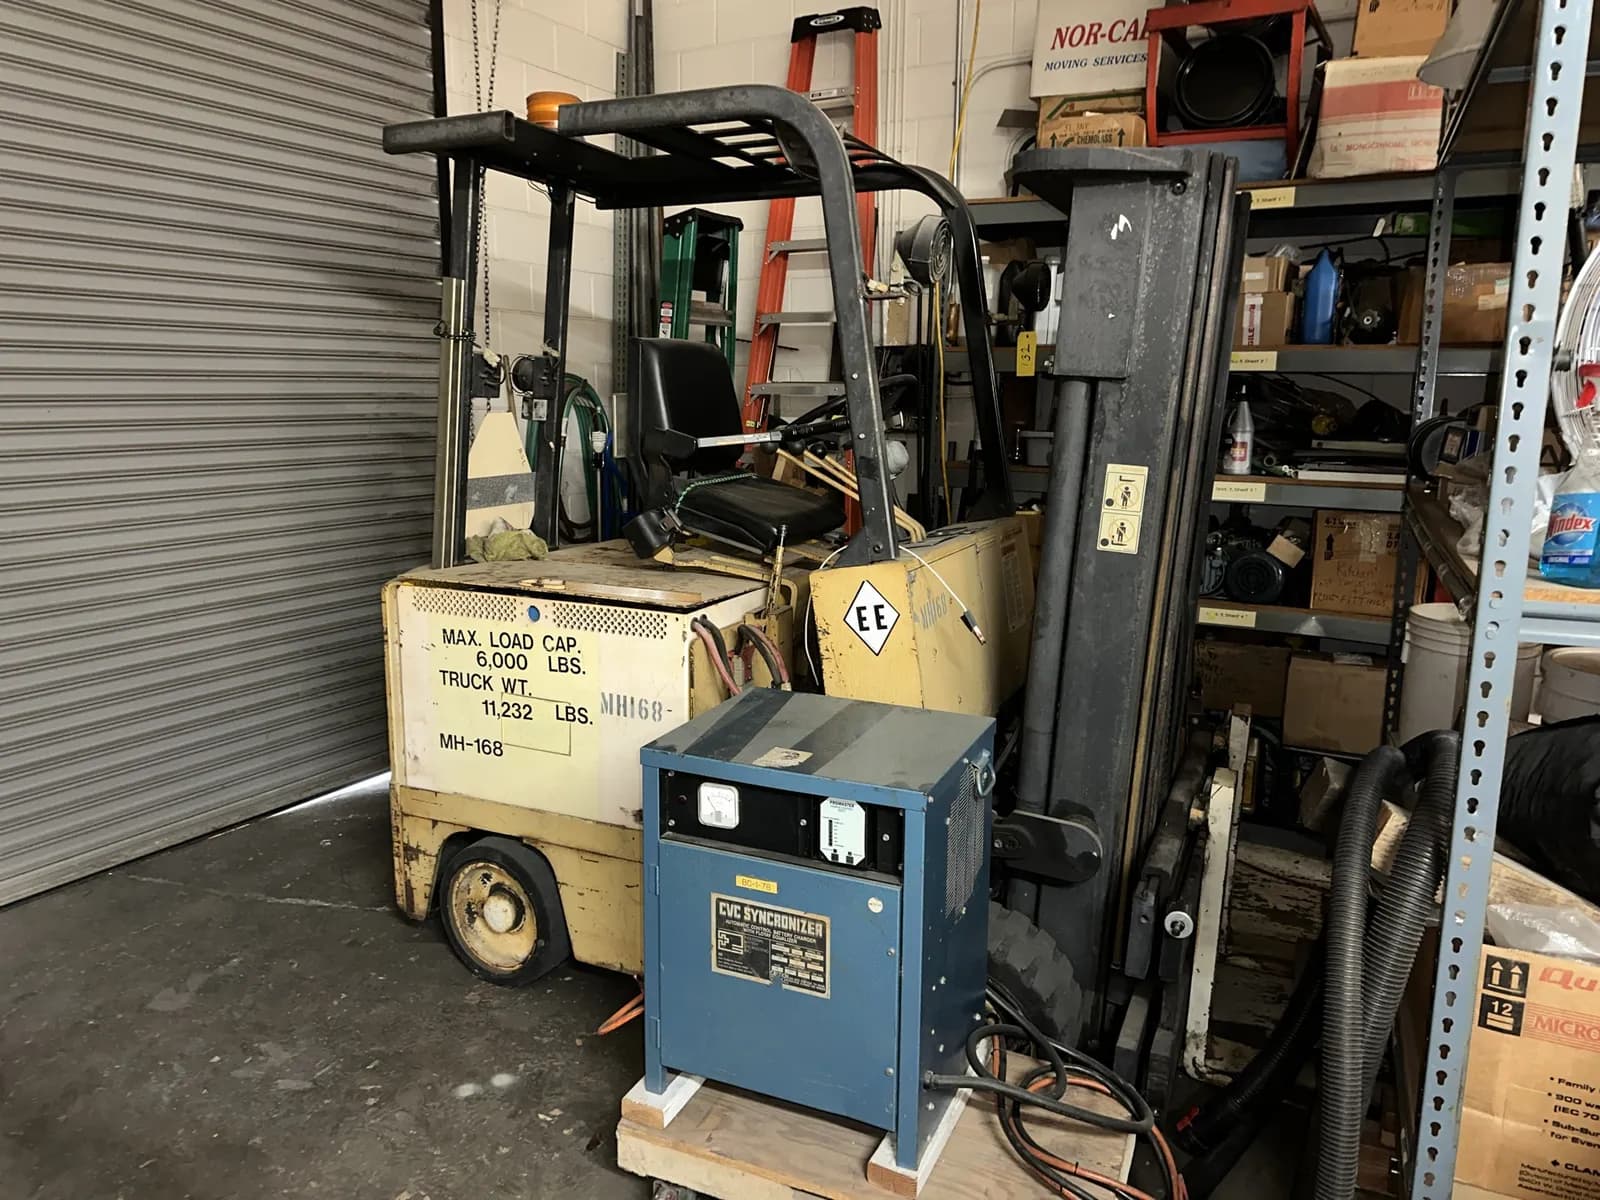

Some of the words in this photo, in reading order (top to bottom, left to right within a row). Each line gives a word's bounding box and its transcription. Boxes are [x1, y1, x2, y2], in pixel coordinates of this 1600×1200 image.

[1044, 58, 1087, 71] MOVING
[1093, 53, 1148, 67] SERVICES
[442, 628, 482, 647] MAX.
[490, 631, 534, 650] LOAD
[543, 634, 582, 653] CAP.
[476, 651, 528, 671] 6,000
[548, 655, 586, 675] LBS.
[439, 670, 494, 692] TRUCK
[501, 677, 533, 697] WT.
[482, 700, 534, 721] 11,232
[555, 705, 594, 725] LBS.
[439, 733, 504, 757] MH-168
[719, 901, 742, 919] CVC
[743, 906, 823, 938] SYNCRONIZER
[1539, 966, 1600, 992] Qu
[1491, 1000, 1513, 1017] 12
[1557, 1077, 1596, 1094] Family
[1550, 1131, 1568, 1141] for
